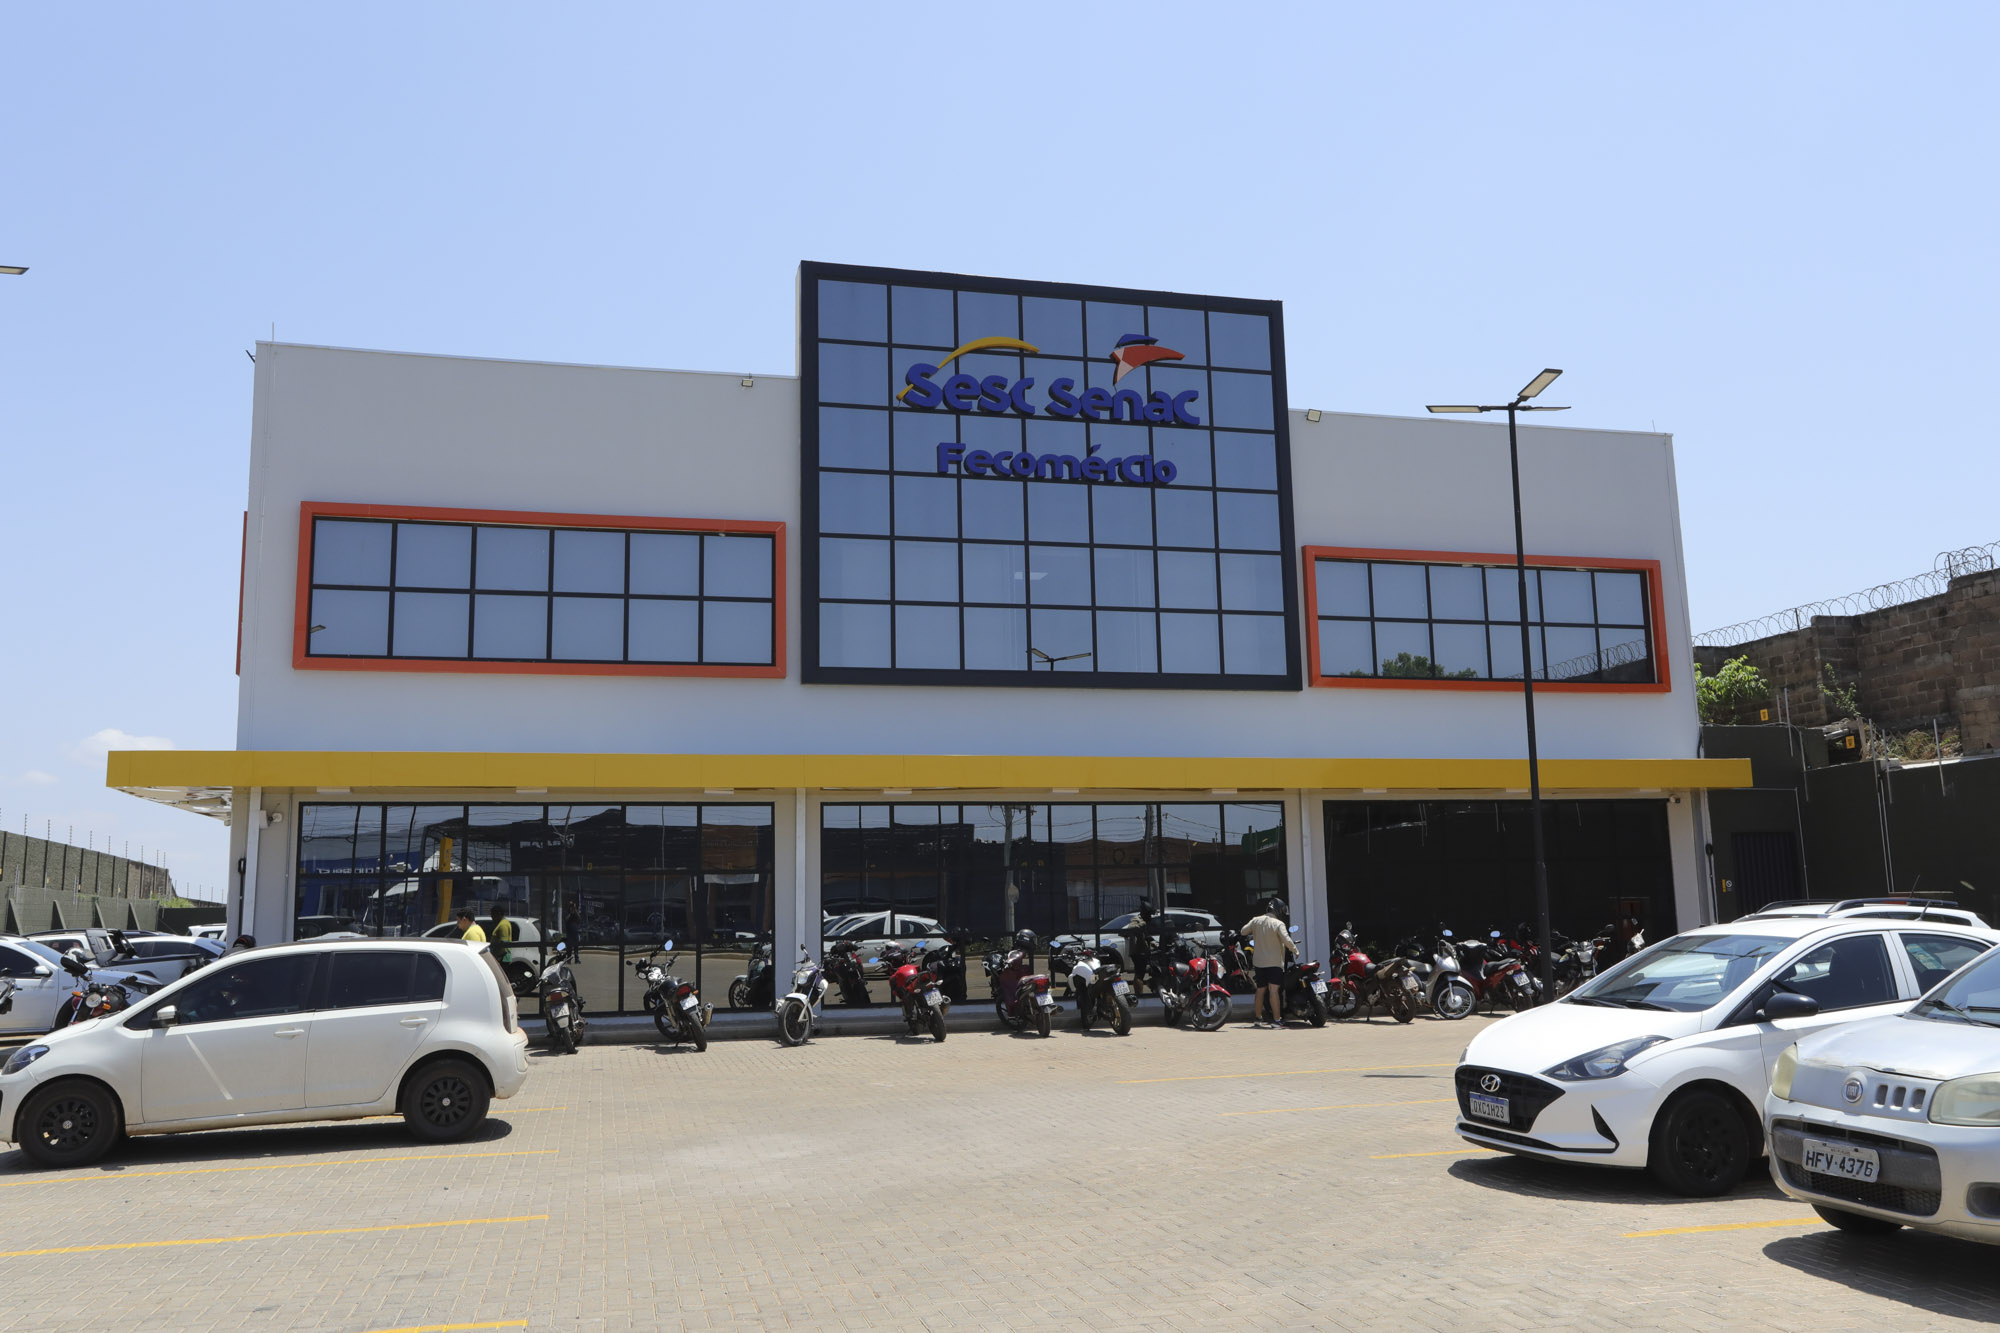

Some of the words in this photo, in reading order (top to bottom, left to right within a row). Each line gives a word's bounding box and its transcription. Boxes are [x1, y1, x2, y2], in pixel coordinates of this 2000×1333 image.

[902, 363, 1035, 415] Sesc
[1045, 377, 1200, 425] Senac
[936, 442, 1177, 484] Fecomércio
